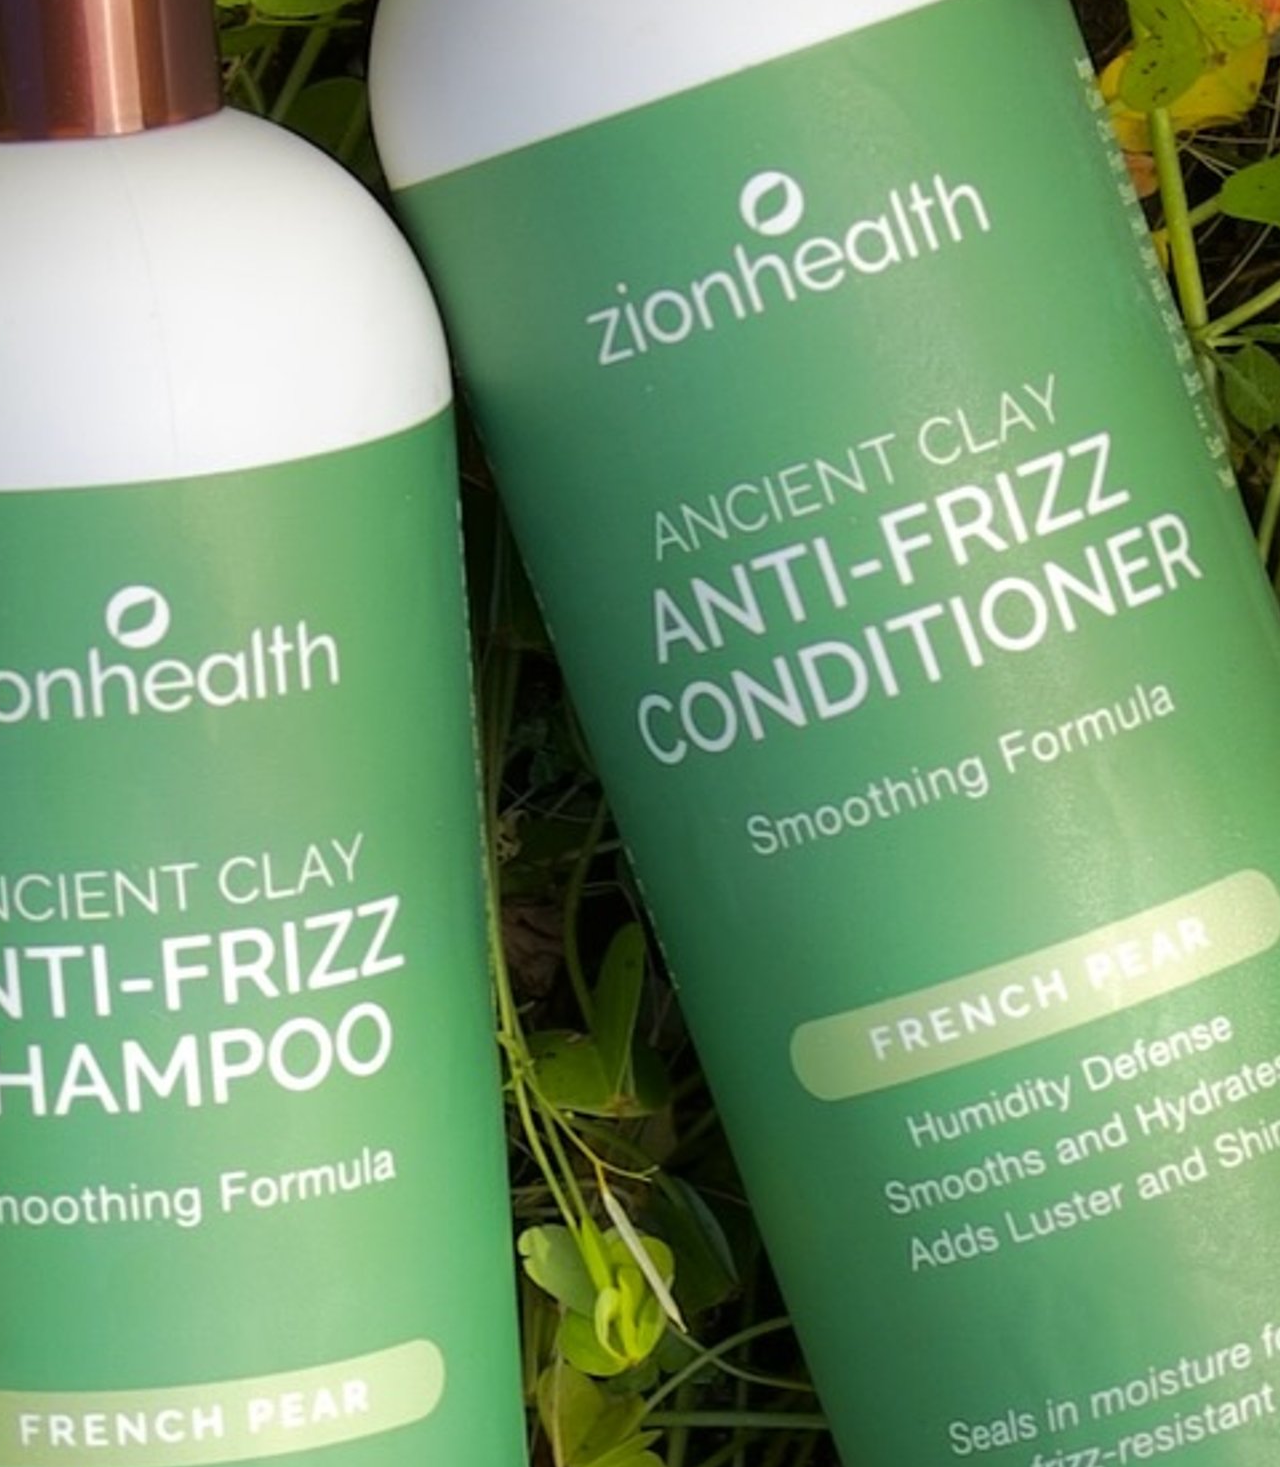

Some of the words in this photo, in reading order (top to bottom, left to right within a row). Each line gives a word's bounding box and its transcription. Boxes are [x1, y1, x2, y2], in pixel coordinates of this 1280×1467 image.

[586, 173, 992, 365] zionhealth
[653, 434, 897, 562] ANCIENT
[917, 374, 1059, 468] CLAY
[651, 432, 1129, 664] ANTI-FRIZZ
[636, 513, 1203, 765] CONDITIONER
[747, 755, 990, 855] Smoothing
[998, 681, 1175, 775] Formula
[218, 833, 364, 905] CLAY
[868, 973, 1069, 1061] FRENCH
[1085, 915, 1213, 991] PEAR
[906, 1068, 1073, 1150] Humidity
[1082, 1014, 1234, 1092] Defense
[221, 1146, 396, 1215] Formula
[883, 1150, 1047, 1217] Smooths
[1056, 1114, 1128, 1166] and
[910, 1224, 1000, 1271] Adds
[1006, 1182, 1125, 1246] Luster
[1137, 1147, 1208, 1201] and
[20, 1404, 225, 1449] FRENCH
[247, 1379, 370, 1435] PEAR
[949, 1411, 1039, 1457] Seals
[1047, 1398, 1079, 1433] in
[1090, 1339, 1253, 1420] moisture
